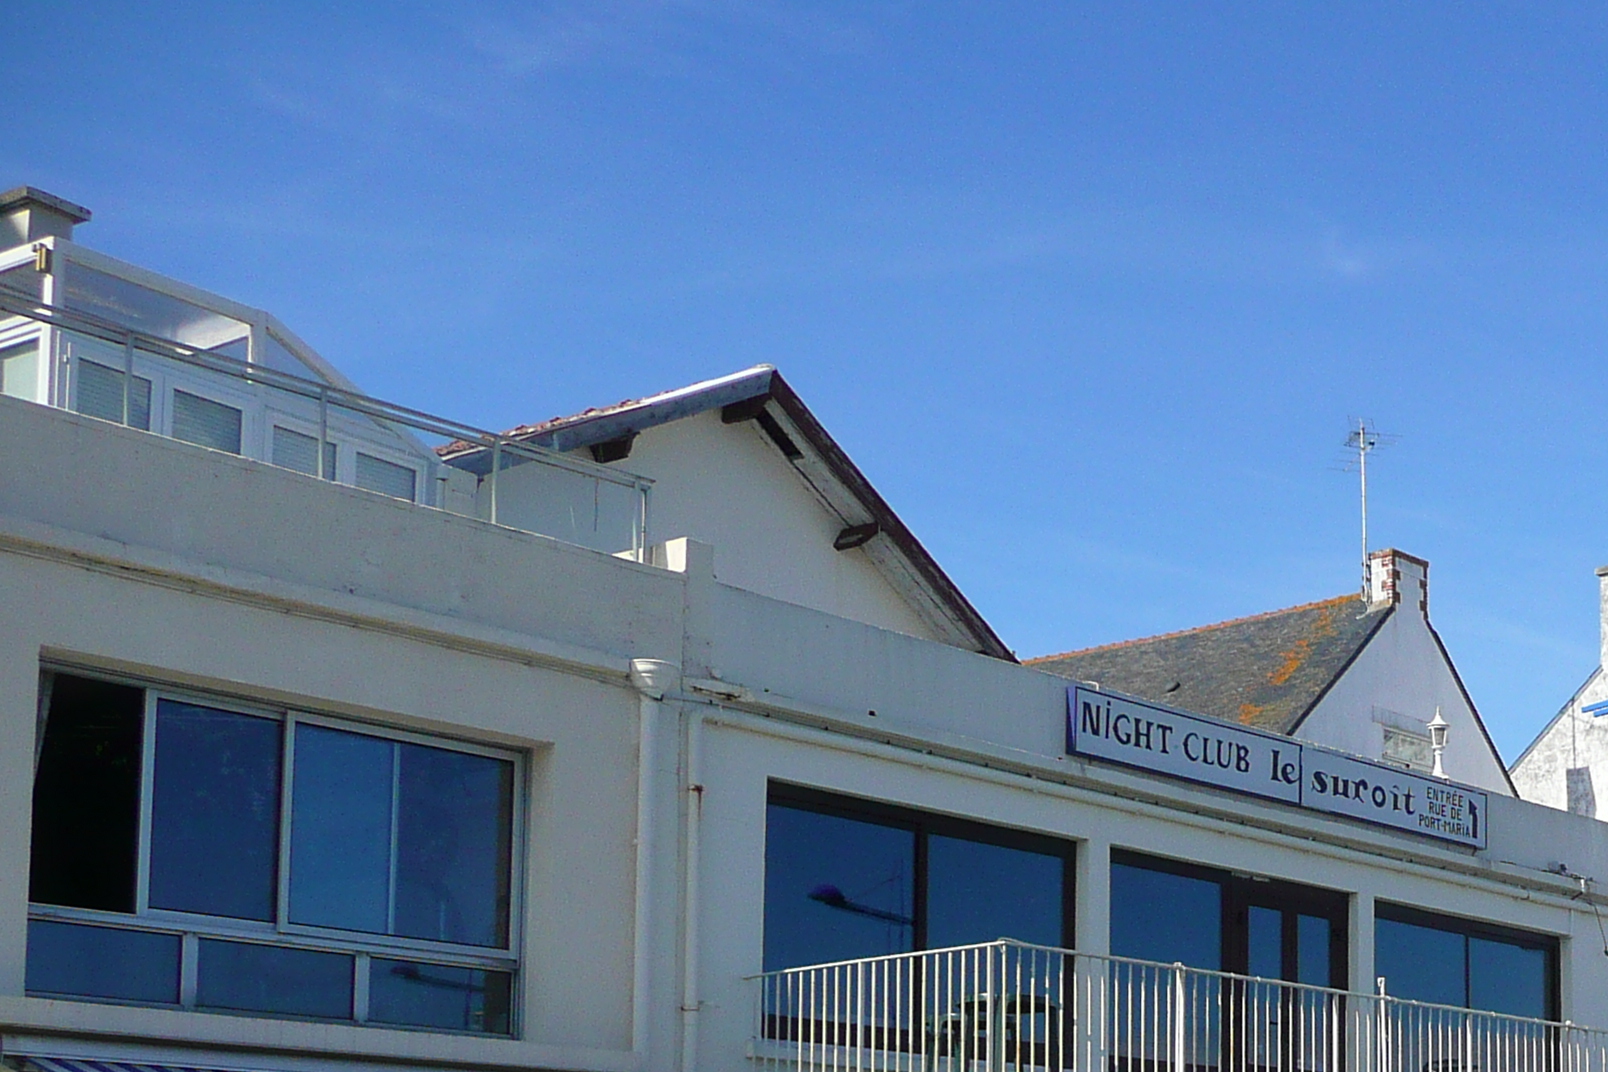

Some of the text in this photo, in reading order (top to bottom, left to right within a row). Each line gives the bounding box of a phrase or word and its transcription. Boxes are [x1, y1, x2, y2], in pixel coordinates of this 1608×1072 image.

[1182, 732, 1251, 774] CLUB
[1270, 749, 1300, 785] le
[1428, 801, 1463, 821] RUE DE
